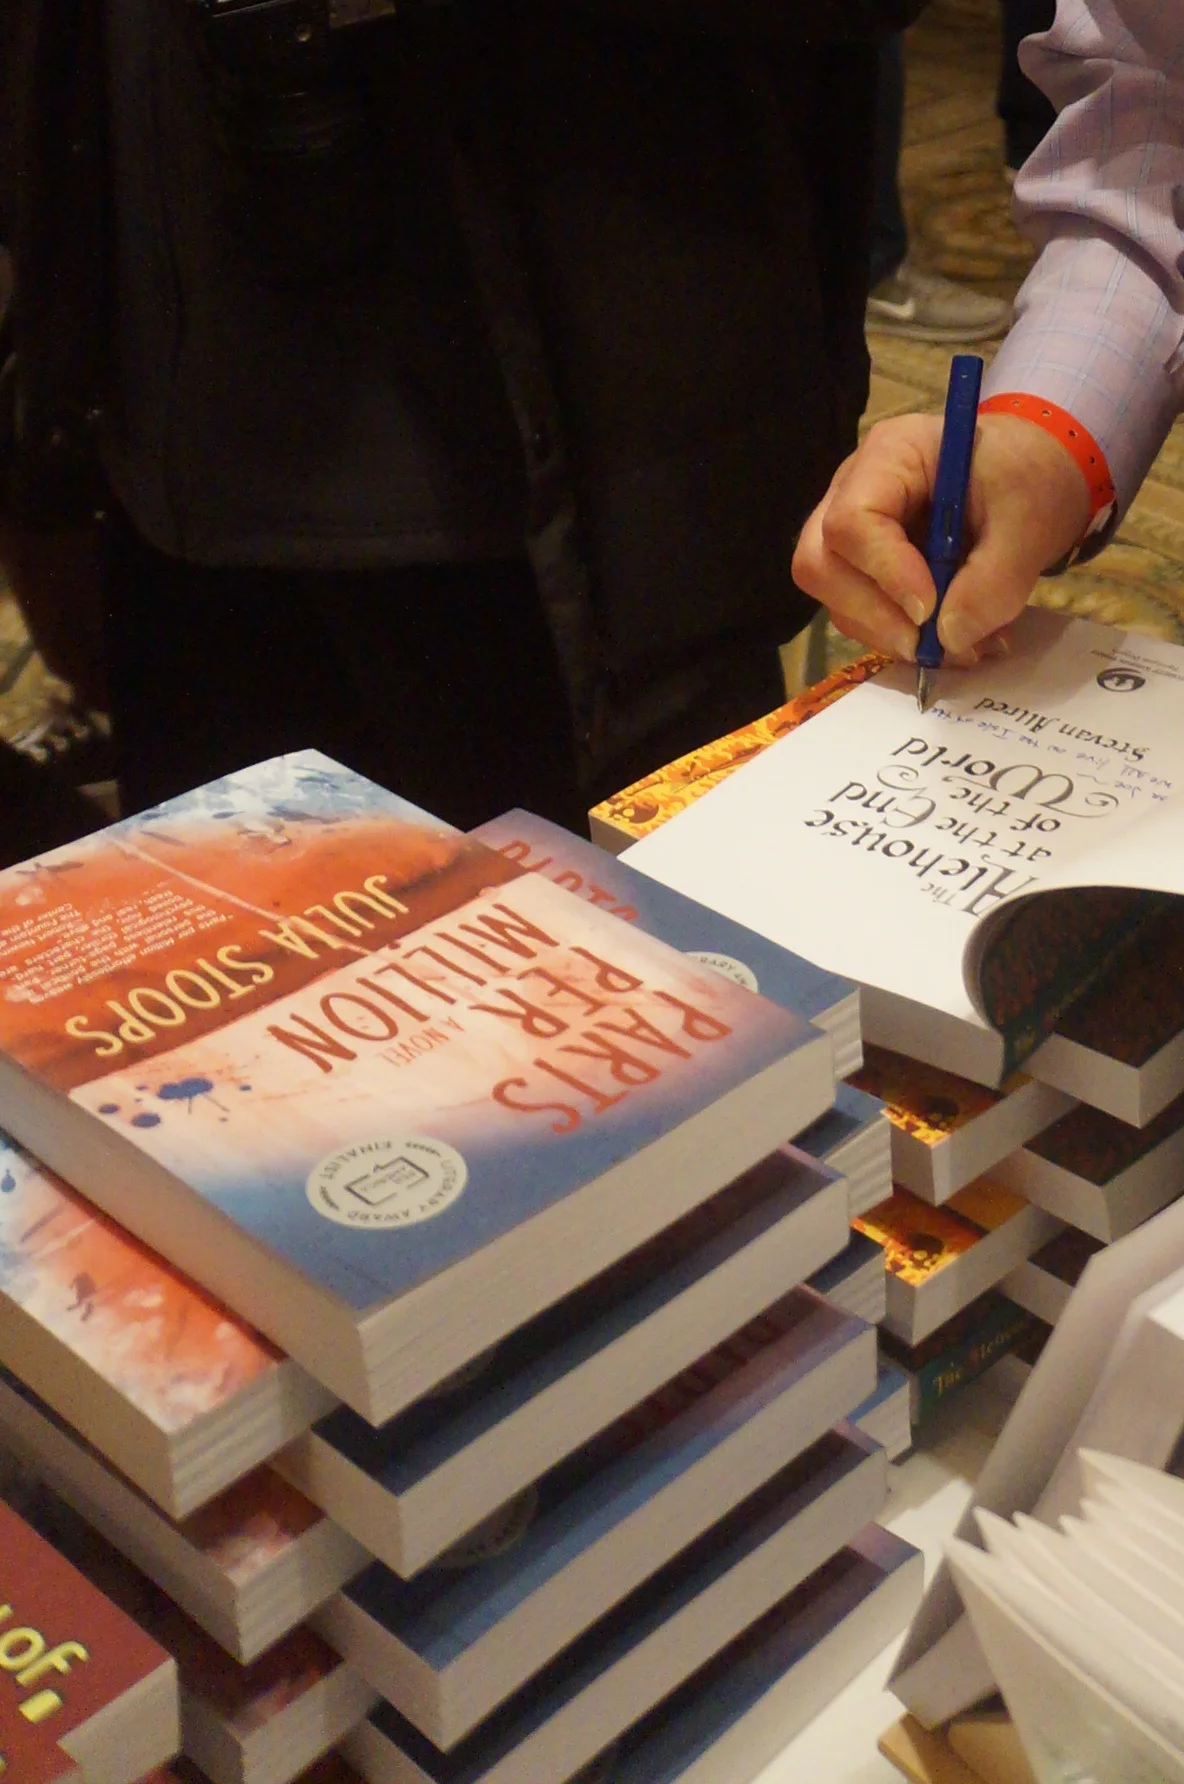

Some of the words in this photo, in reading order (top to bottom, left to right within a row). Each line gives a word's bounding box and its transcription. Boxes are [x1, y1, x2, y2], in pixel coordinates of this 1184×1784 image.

[974, 698, 1060, 733] Allred
[1059, 724, 1150, 762] Stevan
[828, 764, 938, 829] End
[890, 736, 1119, 819] World
[949, 786, 1011, 815] the
[935, 816, 998, 850] the
[1009, 812, 1062, 834] of
[804, 808, 1040, 918] Alehouse
[1001, 841, 1053, 862] at
[920, 881, 956, 907] The
[259, 874, 409, 960] JULIA
[65, 944, 275, 1057] STOOPS
[266, 903, 560, 1074] MILLION
[468, 945, 645, 1041] PER
[448, 1017, 465, 1033] A
[375, 1029, 450, 1068] NOVEL
[491, 989, 733, 1135] PARTS
